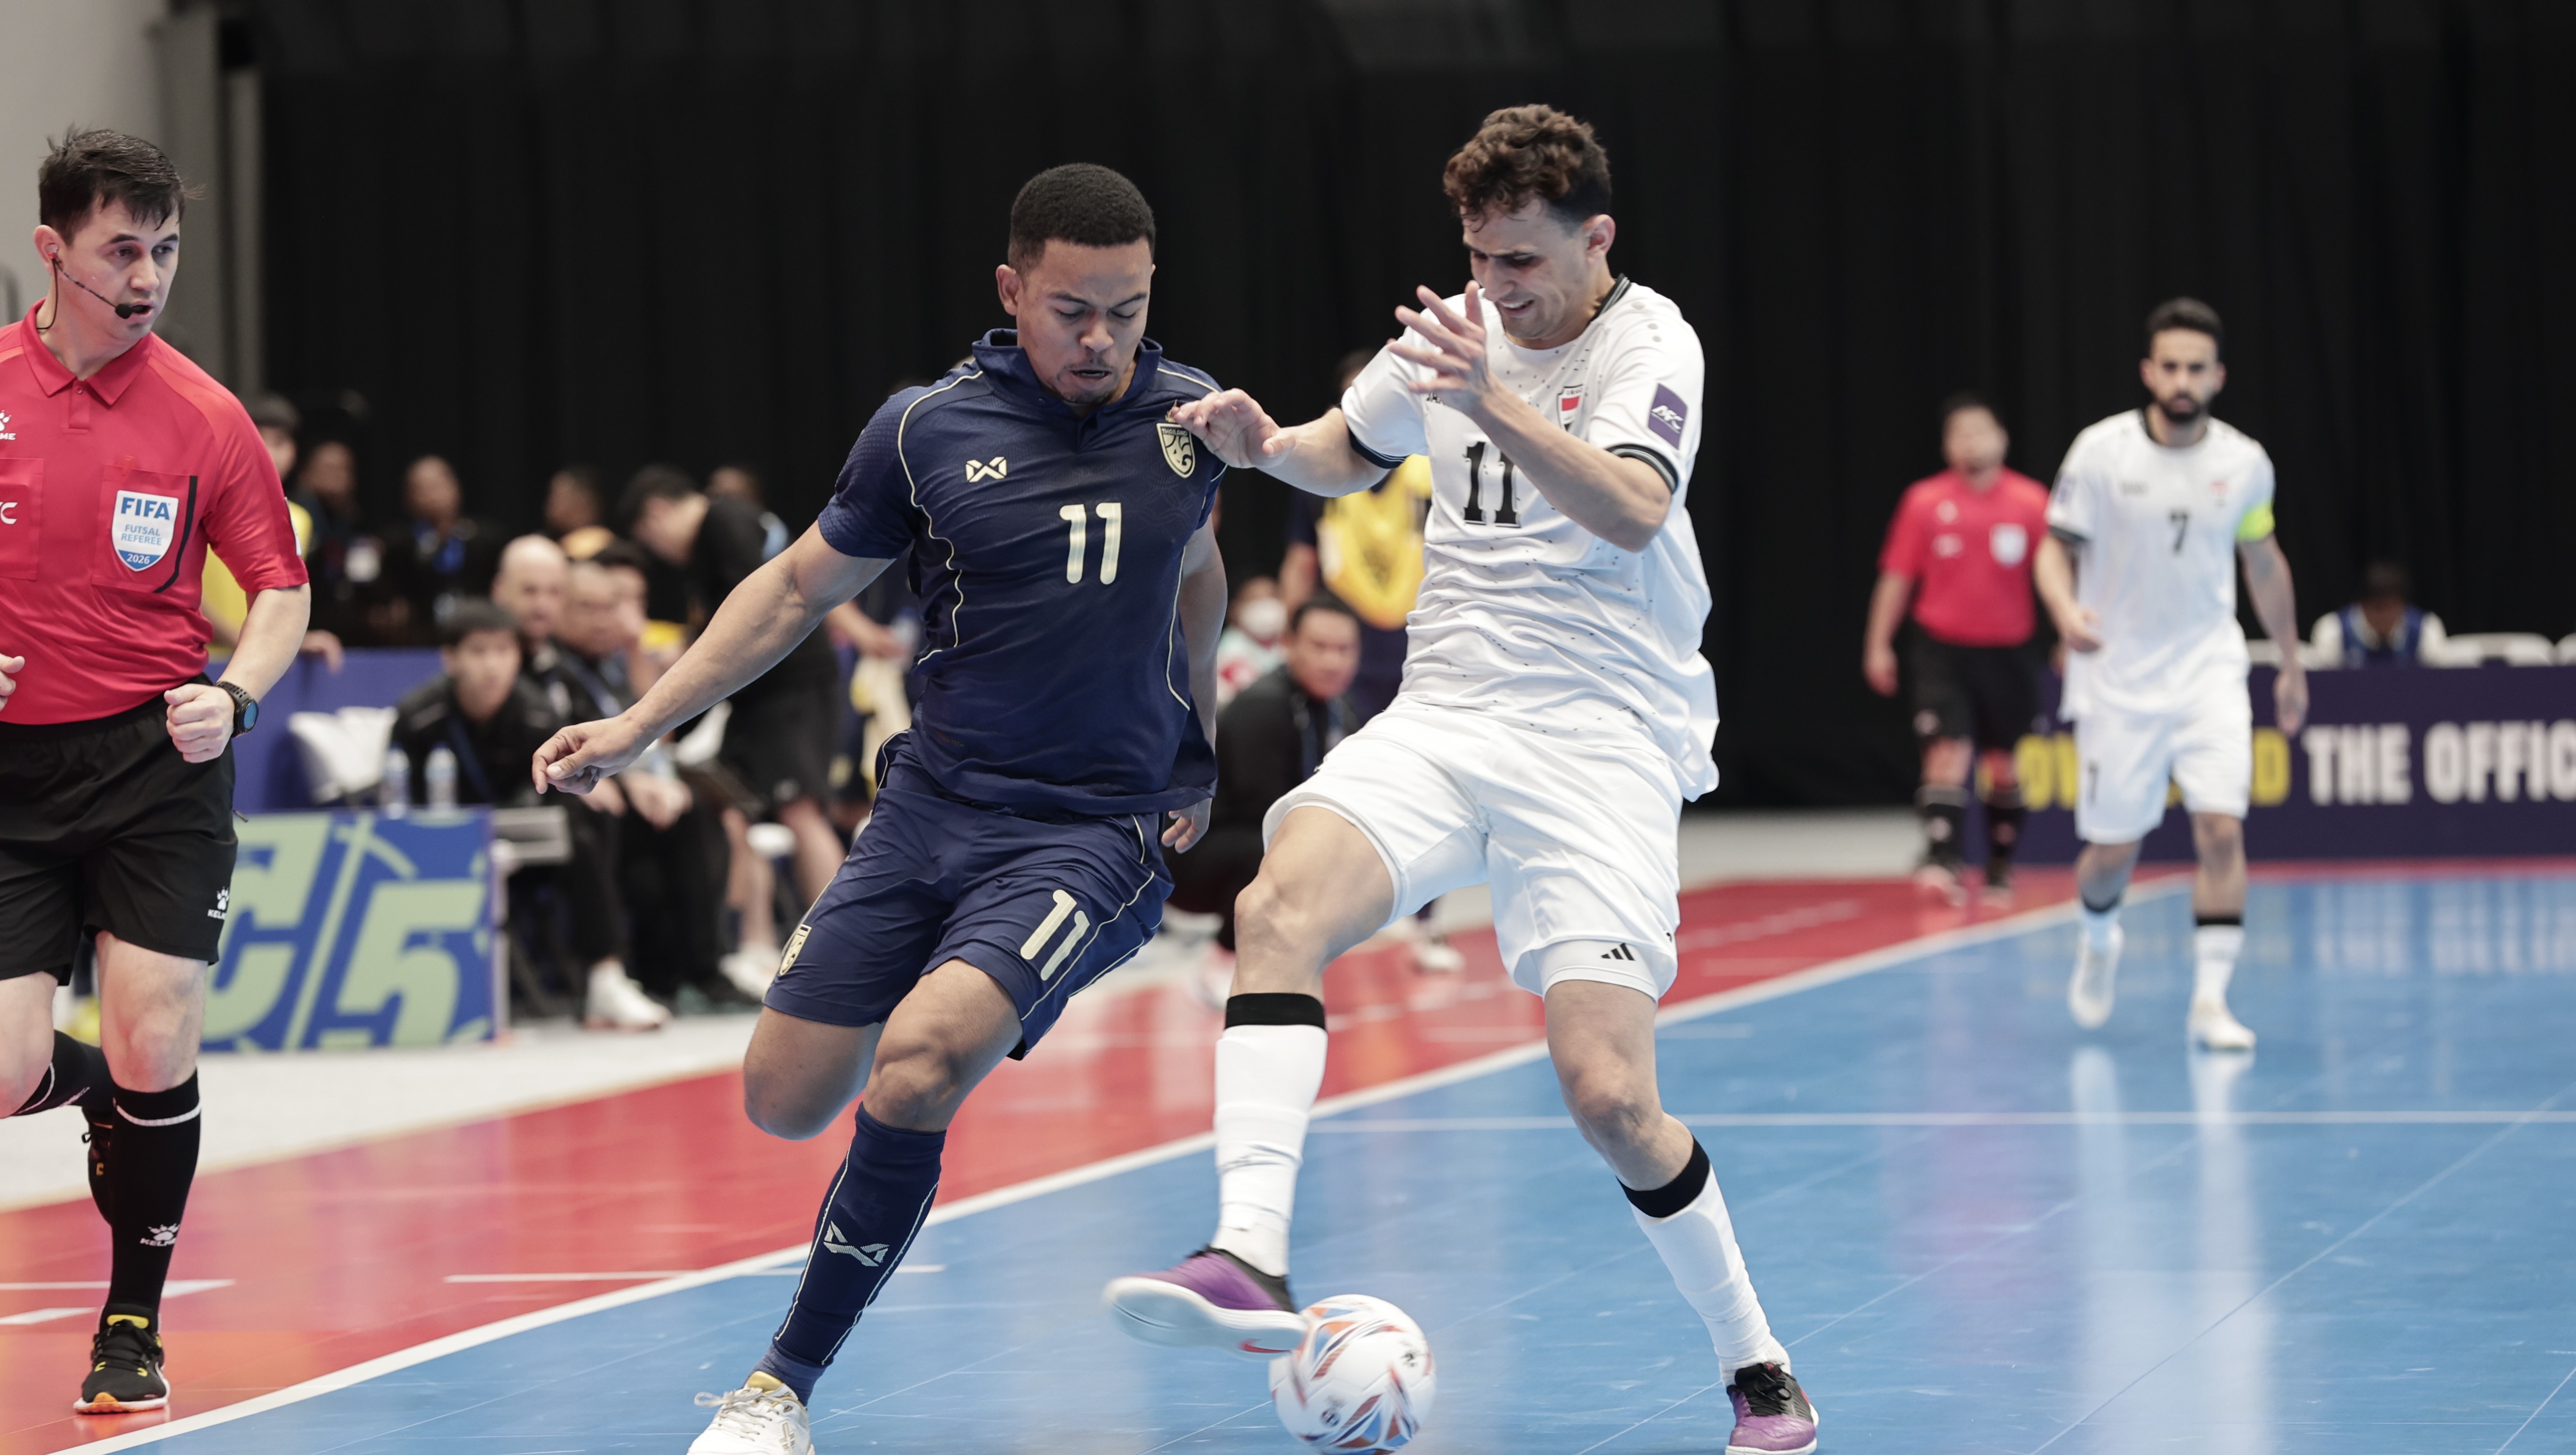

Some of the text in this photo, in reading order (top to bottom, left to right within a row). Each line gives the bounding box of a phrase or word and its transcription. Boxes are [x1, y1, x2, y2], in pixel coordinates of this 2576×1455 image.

[1463, 441, 1521, 528] 11
[0, 501, 18, 524] C
[121, 497, 170, 520] FIFA
[121, 533, 162, 545] REFEREE
[125, 524, 160, 536] FUTSAL
[1059, 502, 1122, 585] 11
[2169, 511, 2190, 553] 7
[127, 553, 150, 564] 2026
[2301, 723, 2413, 806] THE
[1021, 889, 1090, 981] 11
